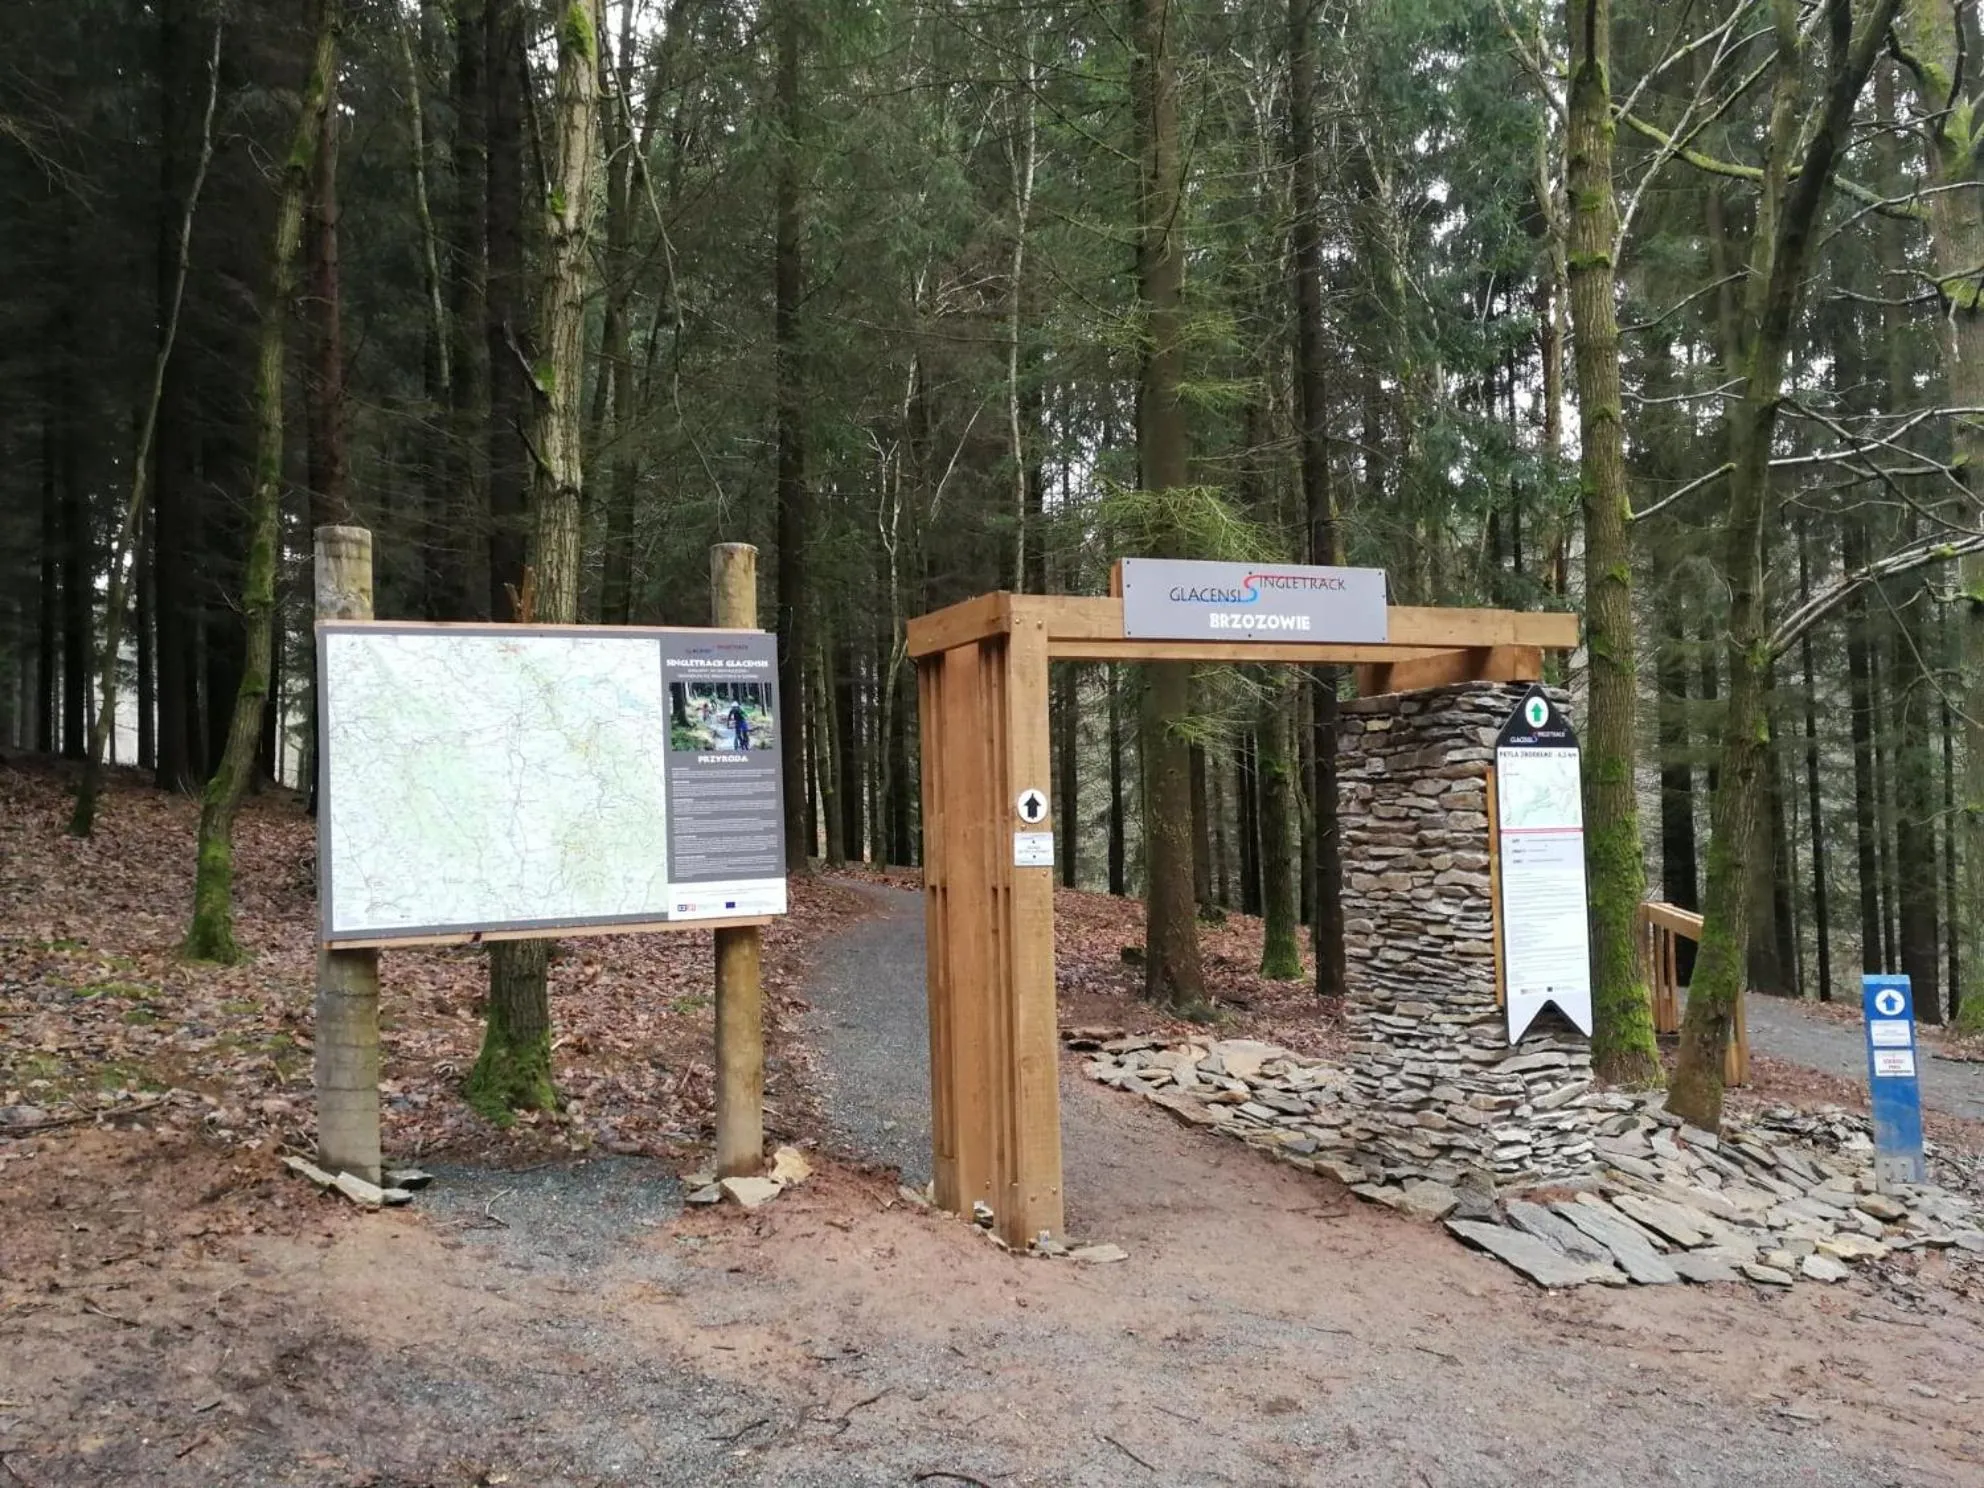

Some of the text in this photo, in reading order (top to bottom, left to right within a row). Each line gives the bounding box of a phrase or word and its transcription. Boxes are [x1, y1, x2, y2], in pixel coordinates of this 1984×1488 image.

[1209, 612, 1311, 631] BRZOZOWIE
[666, 659, 724, 667] SINGLETRACK
[697, 755, 749, 764] PRZYRODA
